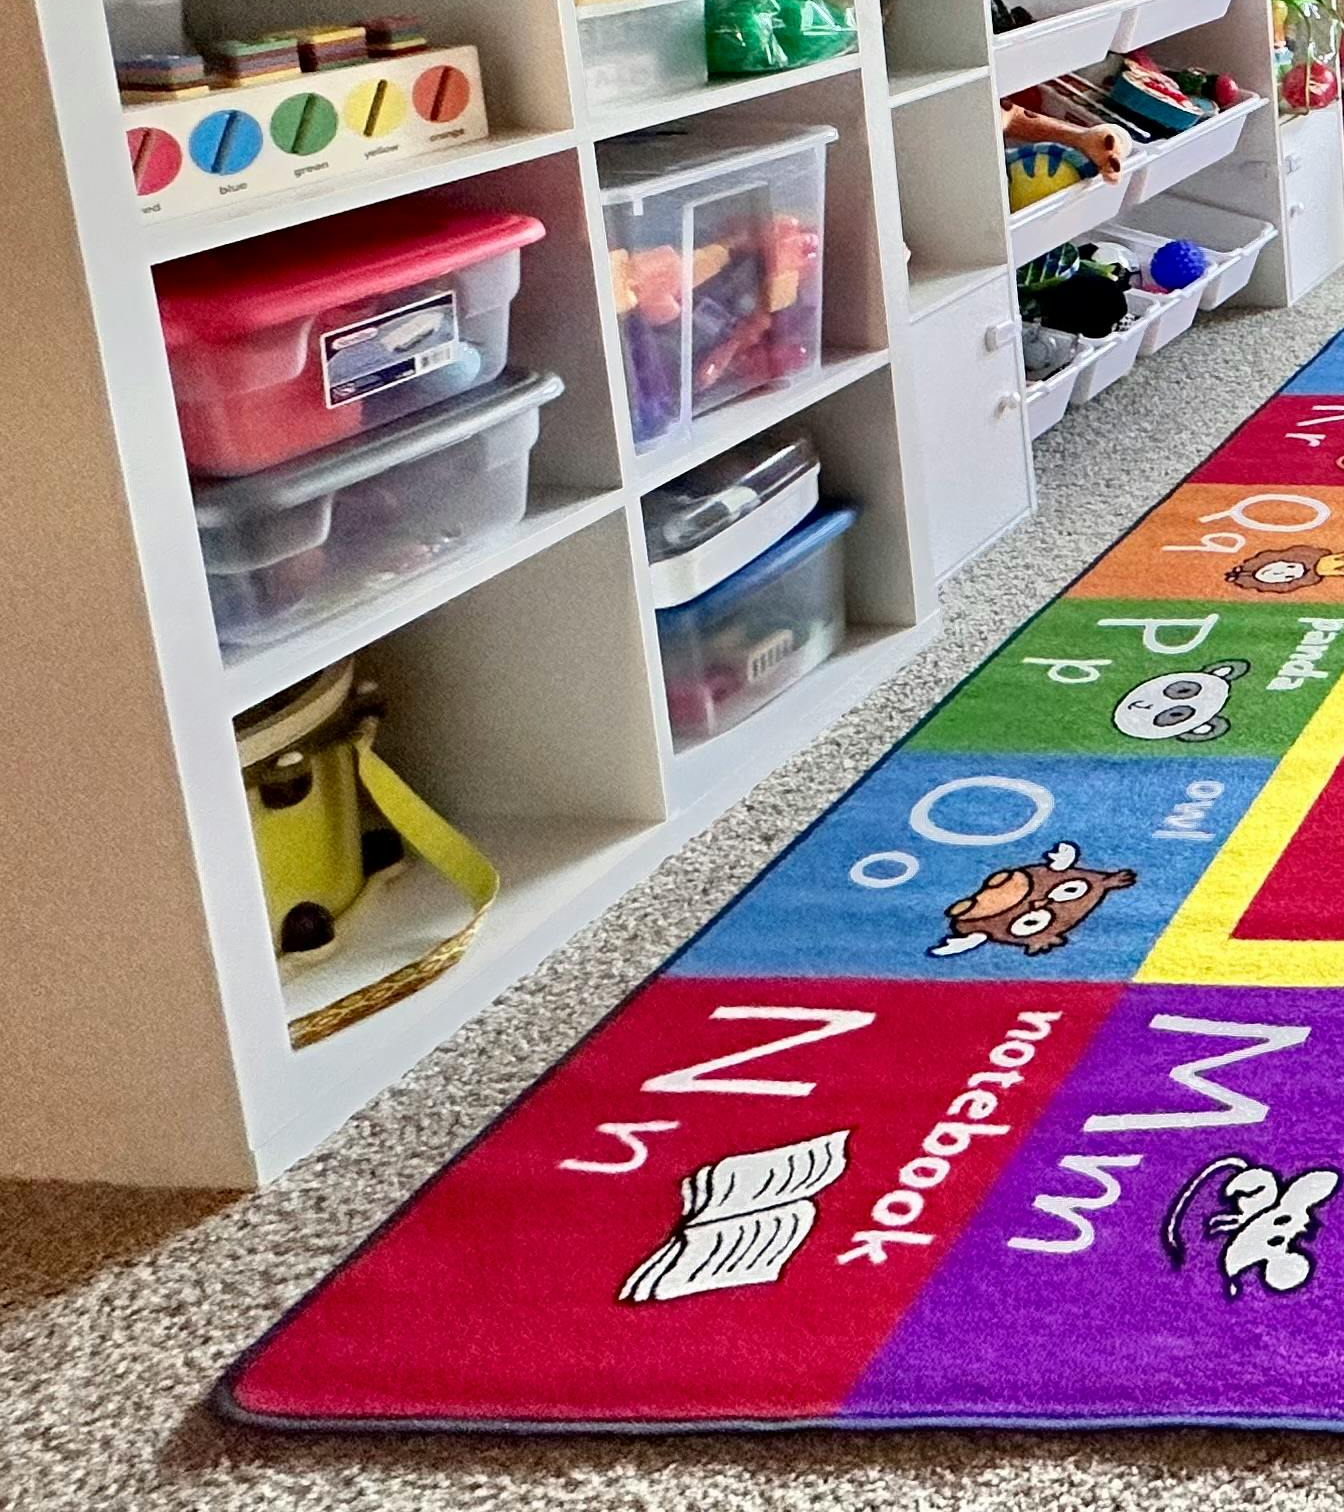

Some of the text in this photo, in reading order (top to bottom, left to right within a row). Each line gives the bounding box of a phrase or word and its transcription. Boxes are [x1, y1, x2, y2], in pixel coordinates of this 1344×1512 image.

[293, 161, 330, 179] green
[364, 144, 400, 160] yellow
[218, 181, 249, 196] blue
[1160, 492, 1332, 554] Qq
[1021, 612, 1221, 685] Pp
[848, 774, 1056, 890] Oo
[1151, 780, 1226, 842] owl
[557, 1005, 877, 1175] Nn
[836, 1009, 1064, 1267] notebook
[1006, 1013, 1313, 1254] Mm
